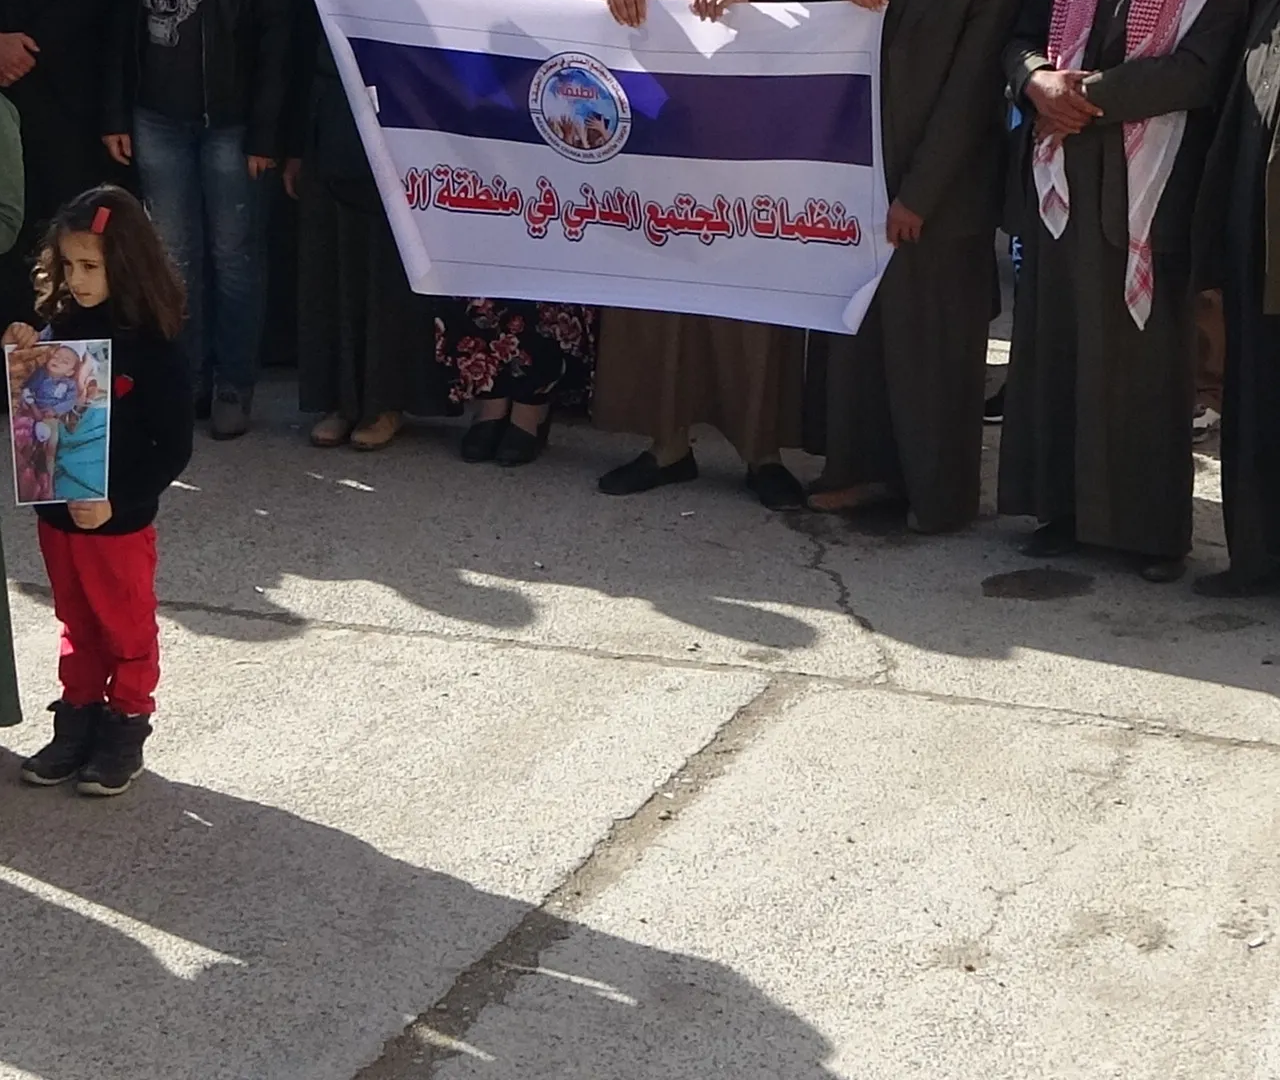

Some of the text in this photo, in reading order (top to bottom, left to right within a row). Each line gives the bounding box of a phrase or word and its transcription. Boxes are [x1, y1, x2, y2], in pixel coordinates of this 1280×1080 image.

[433, 164, 523, 216] منطقة
[524, 176, 560, 239] في
[562, 183, 641, 240] المدني
[644, 193, 748, 246] المجتمع
[750, 194, 861, 246] منظمات
